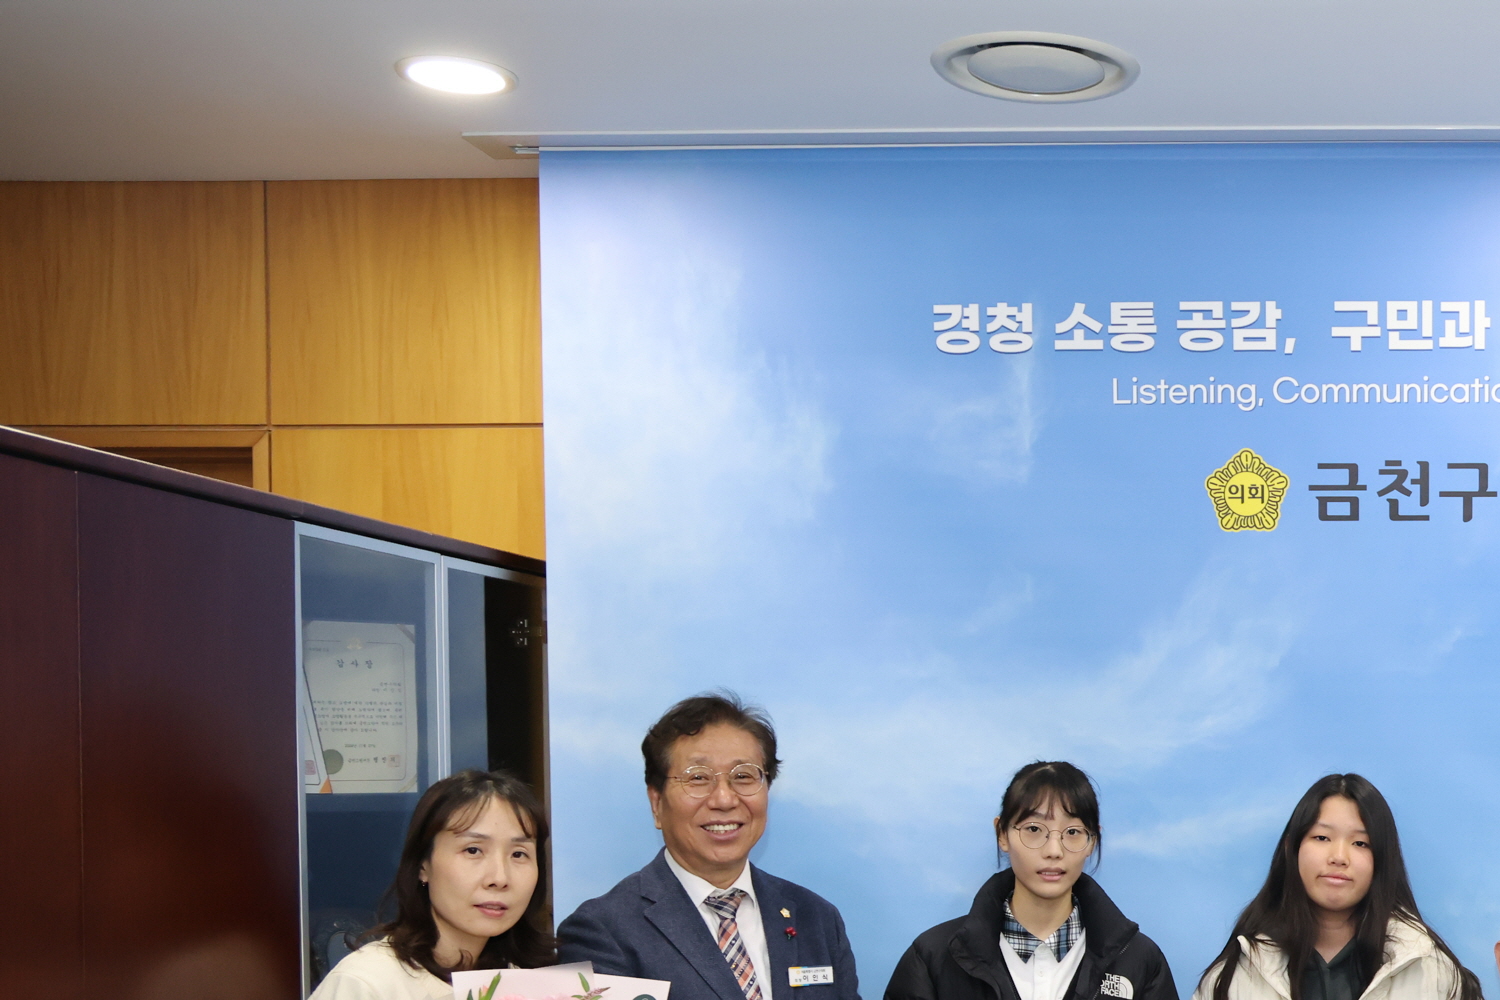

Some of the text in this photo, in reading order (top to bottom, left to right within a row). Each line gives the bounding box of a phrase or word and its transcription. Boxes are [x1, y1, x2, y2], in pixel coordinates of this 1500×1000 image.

[932, 301, 1034, 354] 경청
[1054, 301, 1157, 353] 소통
[1176, 300, 1297, 355] 공감,
[1331, 300, 1491, 352] 구민과
[1112, 376, 1264, 411] Listening,
[1228, 483, 1265, 505] 의회
